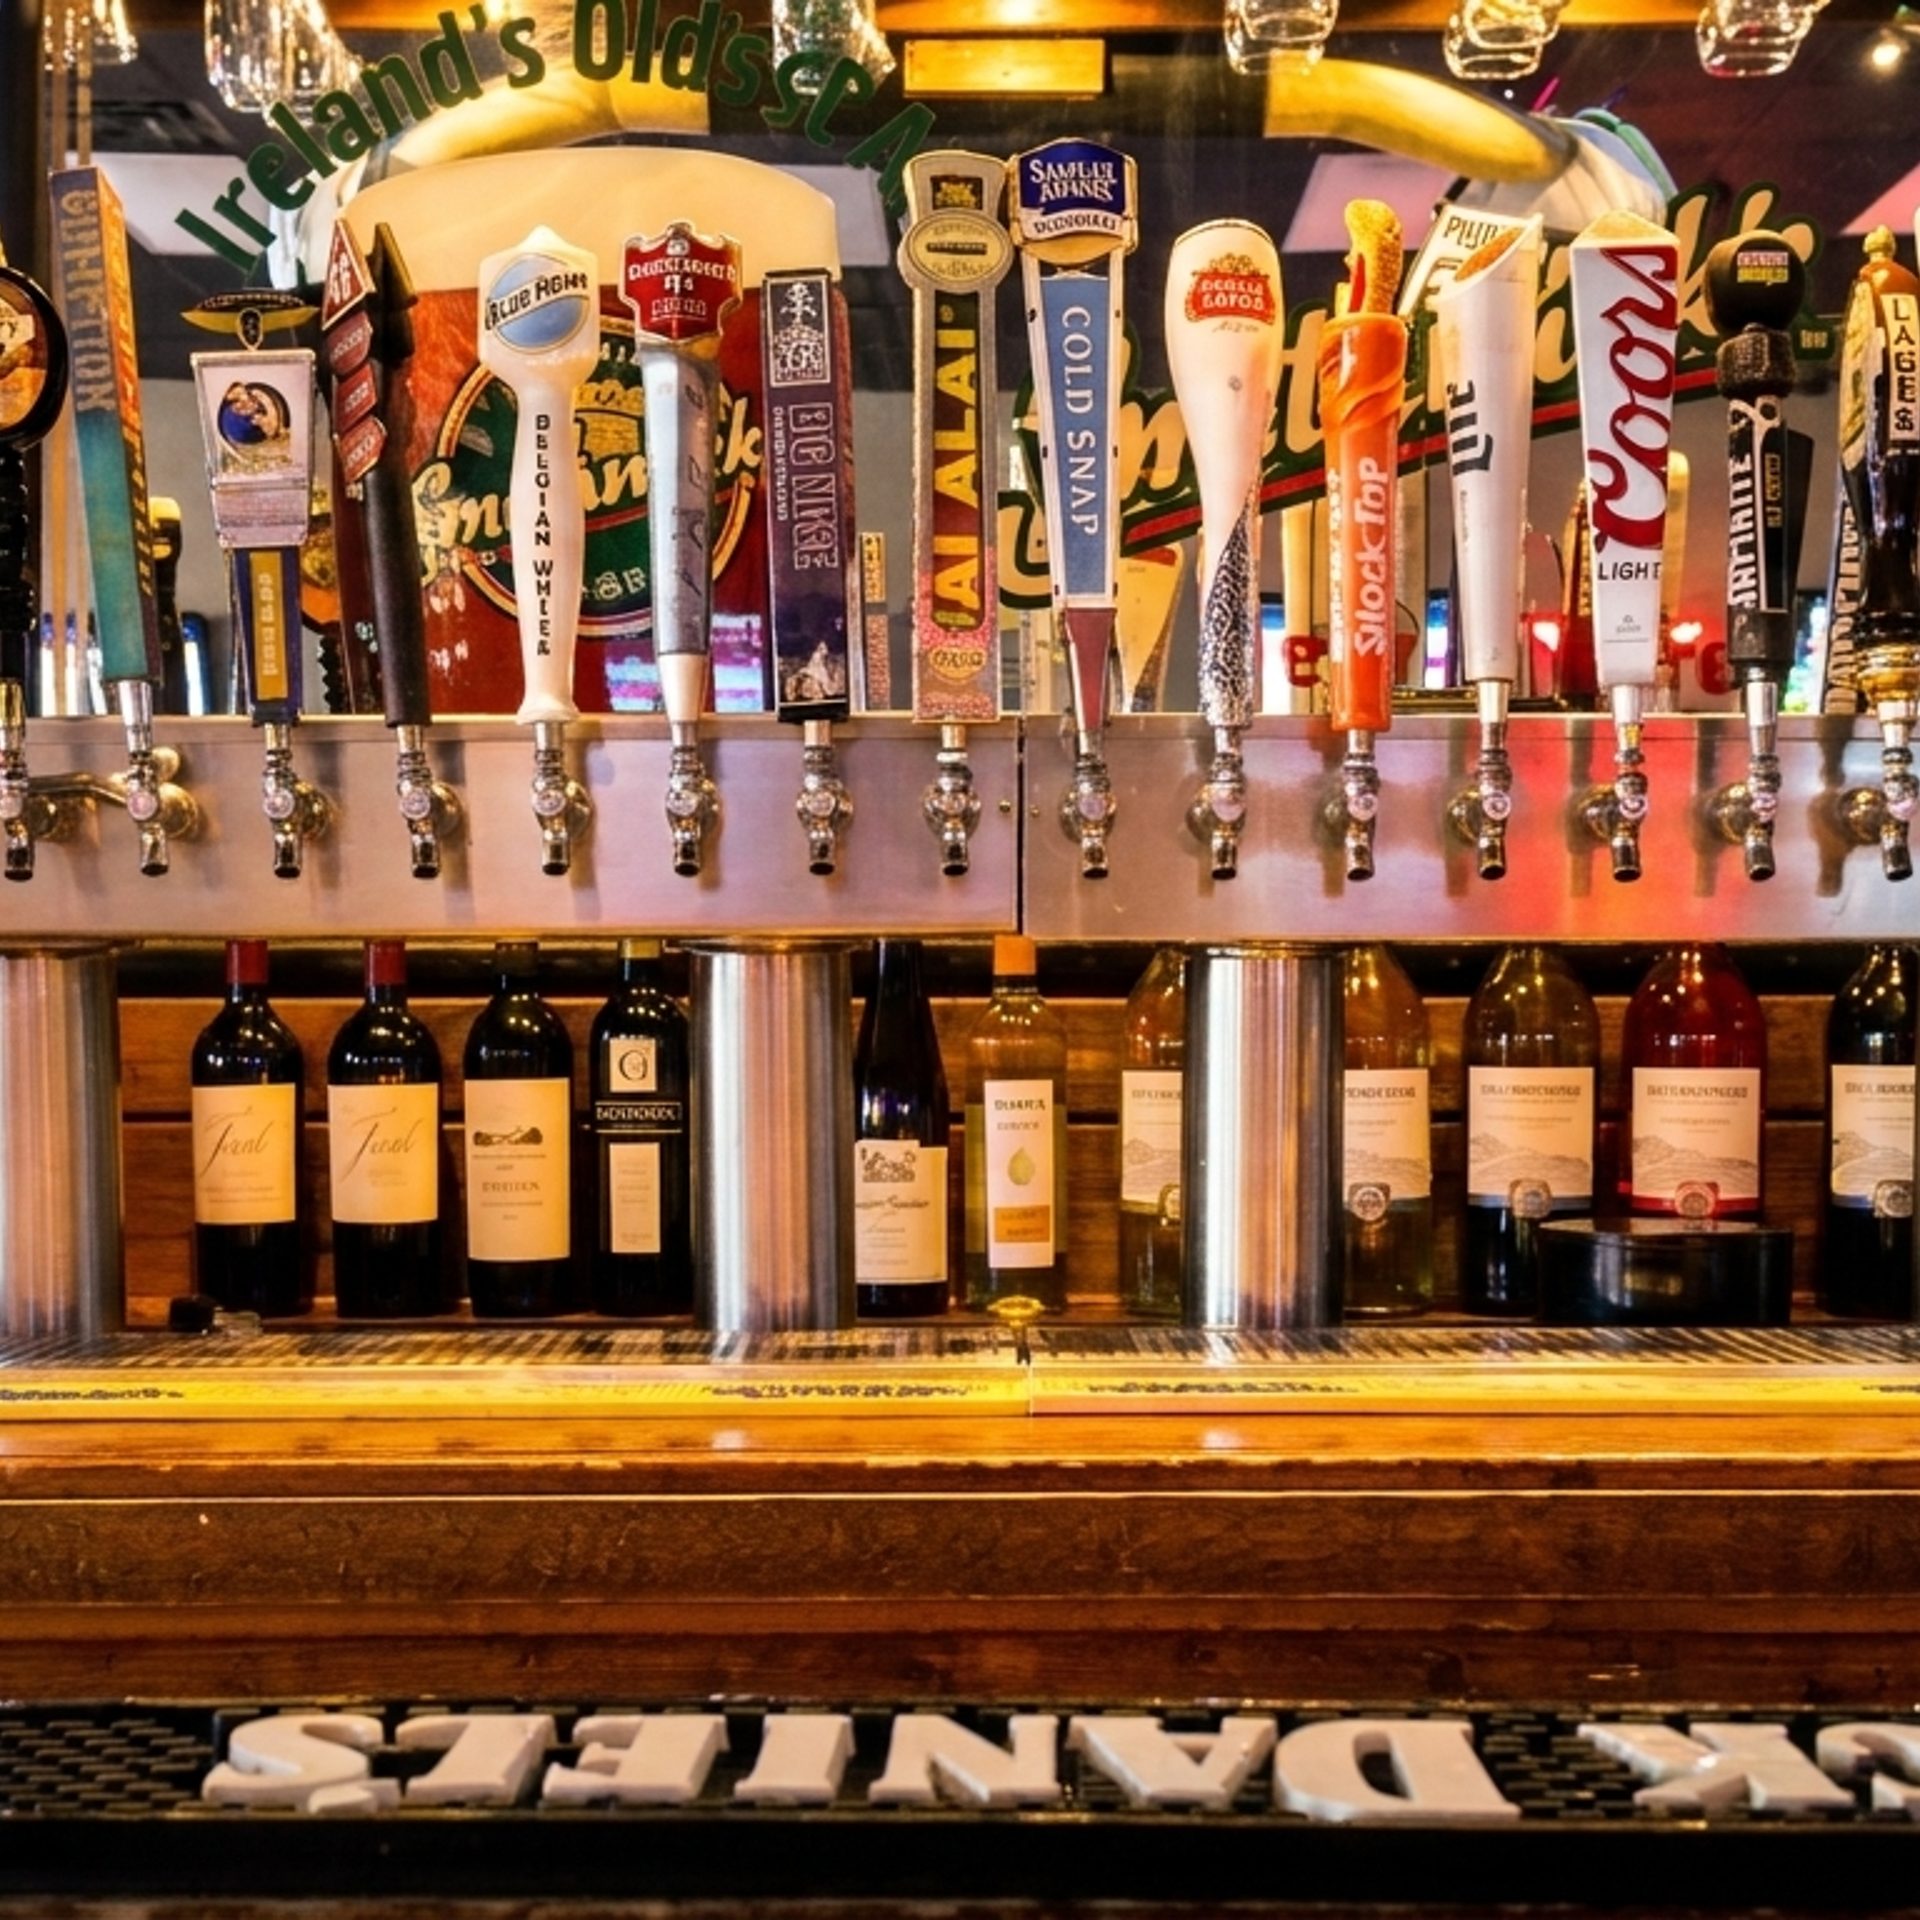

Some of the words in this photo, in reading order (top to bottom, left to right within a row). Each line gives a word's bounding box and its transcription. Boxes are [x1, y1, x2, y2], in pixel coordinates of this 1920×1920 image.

[934, 329, 979, 511] ALAI
[1061, 306, 1094, 415] COLD
[1588, 246, 1679, 553] Coors
[1066, 429, 1099, 536] SNAP
